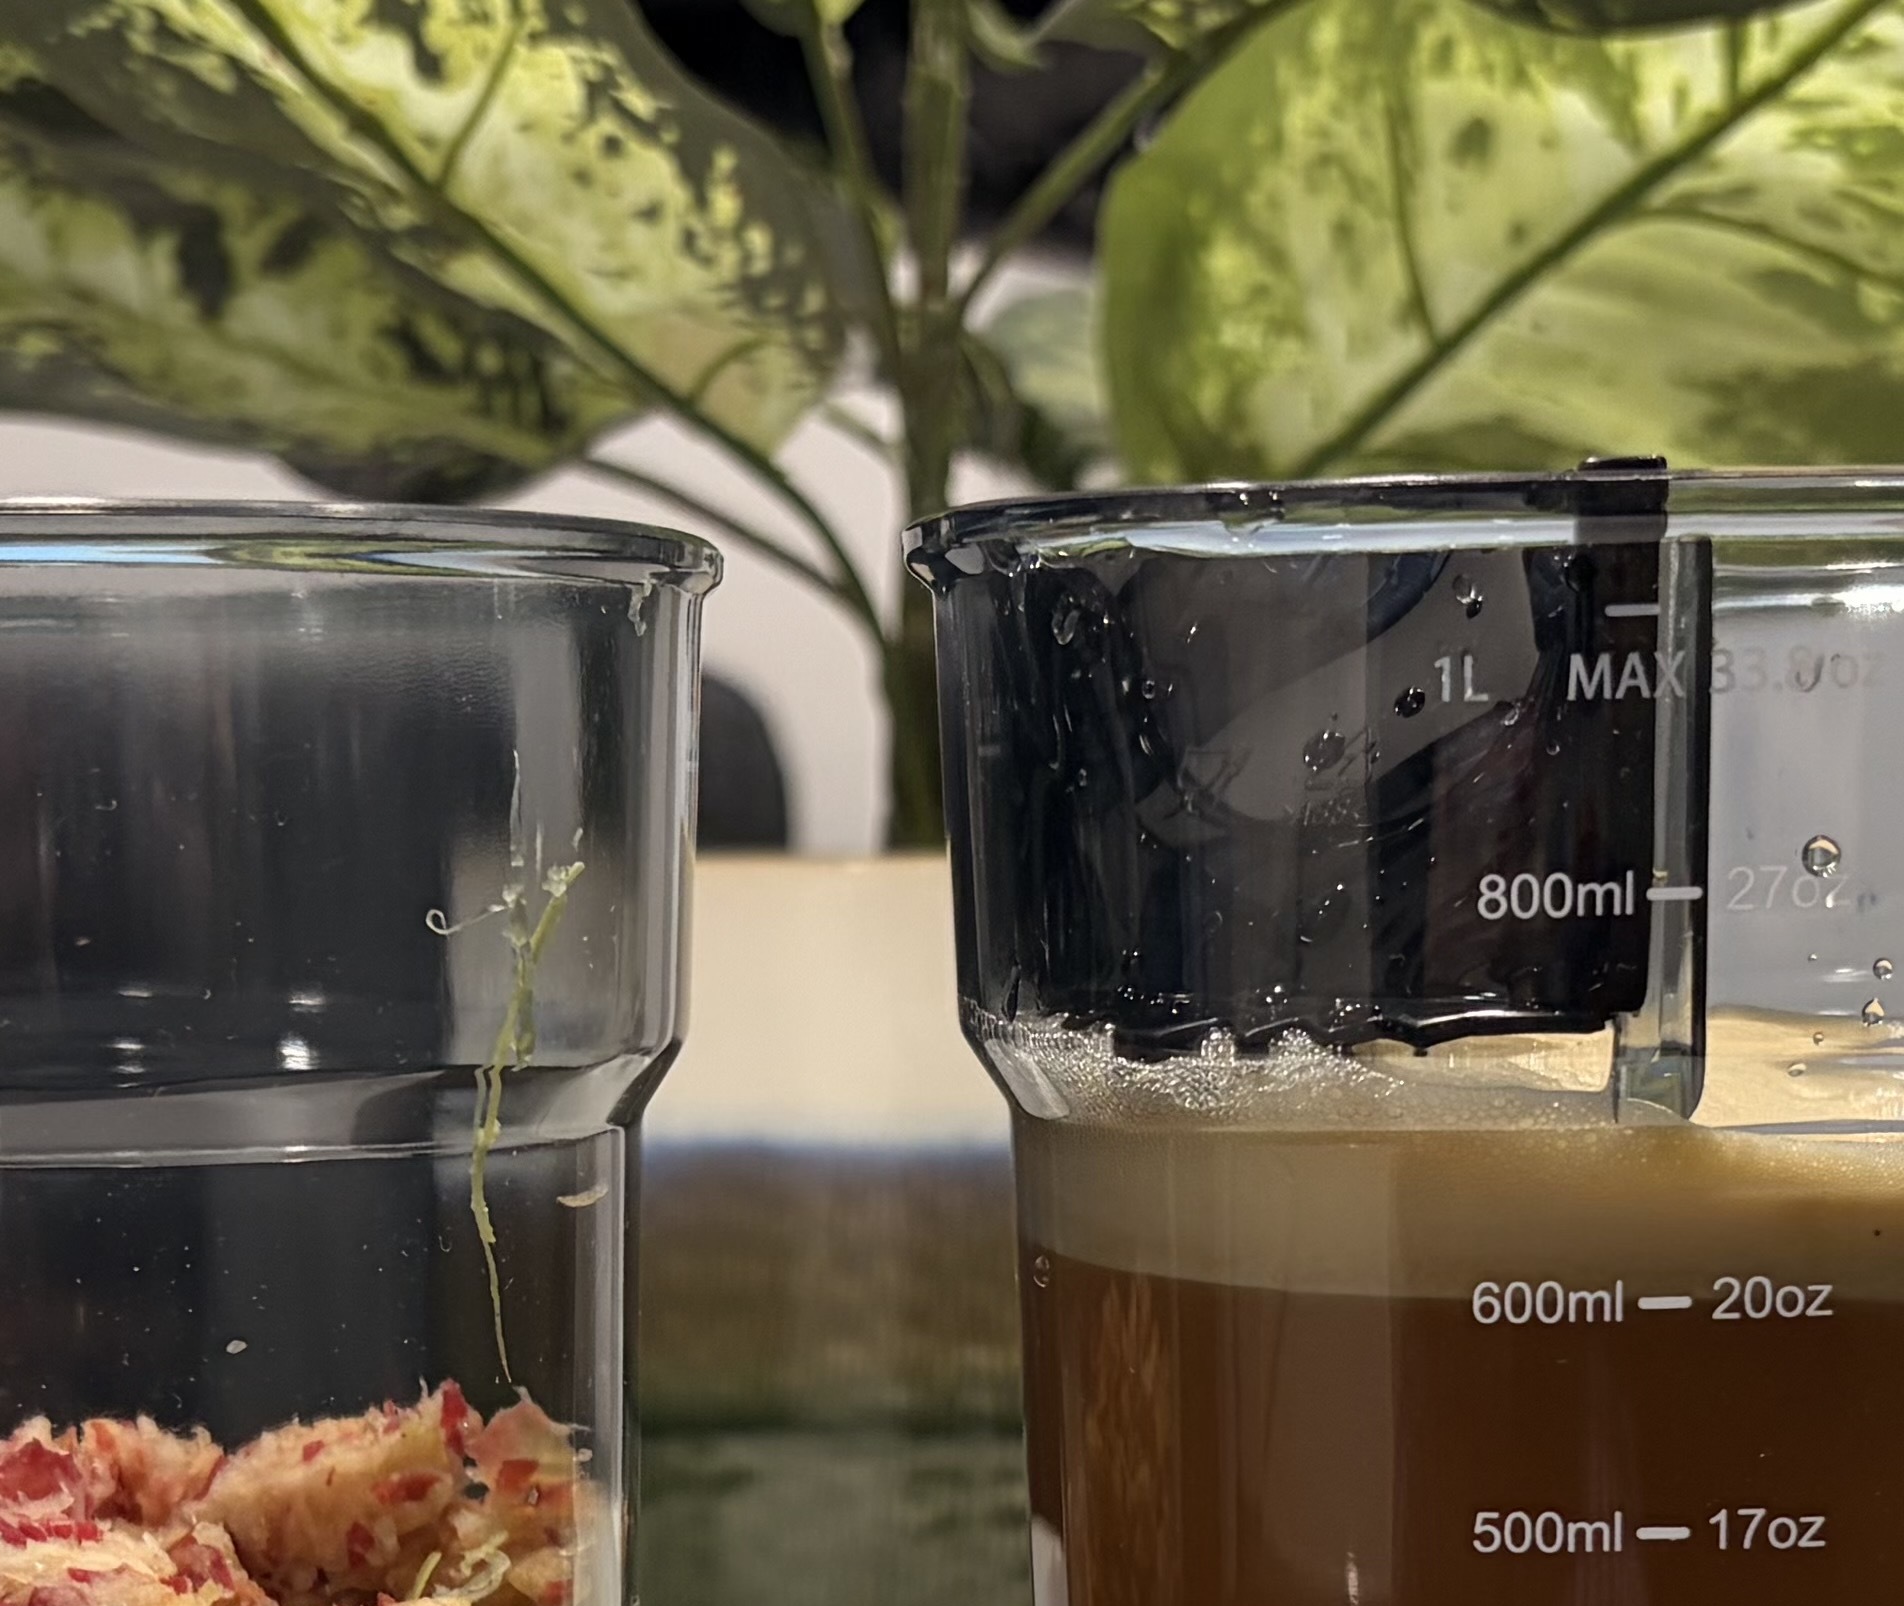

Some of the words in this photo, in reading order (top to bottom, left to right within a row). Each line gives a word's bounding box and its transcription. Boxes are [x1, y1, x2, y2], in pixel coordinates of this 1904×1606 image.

[1432, 655, 1488, 702] 1L
[1567, 652, 1686, 700] MAX
[1476, 871, 1635, 920] 800ml
[1726, 865, 1852, 911] 27oz
[1471, 1279, 1624, 1324] 600ml
[1711, 1276, 1834, 1319] 20oz
[1472, 1510, 1623, 1553] 500ml
[1708, 1508, 1826, 1550] 17oz
